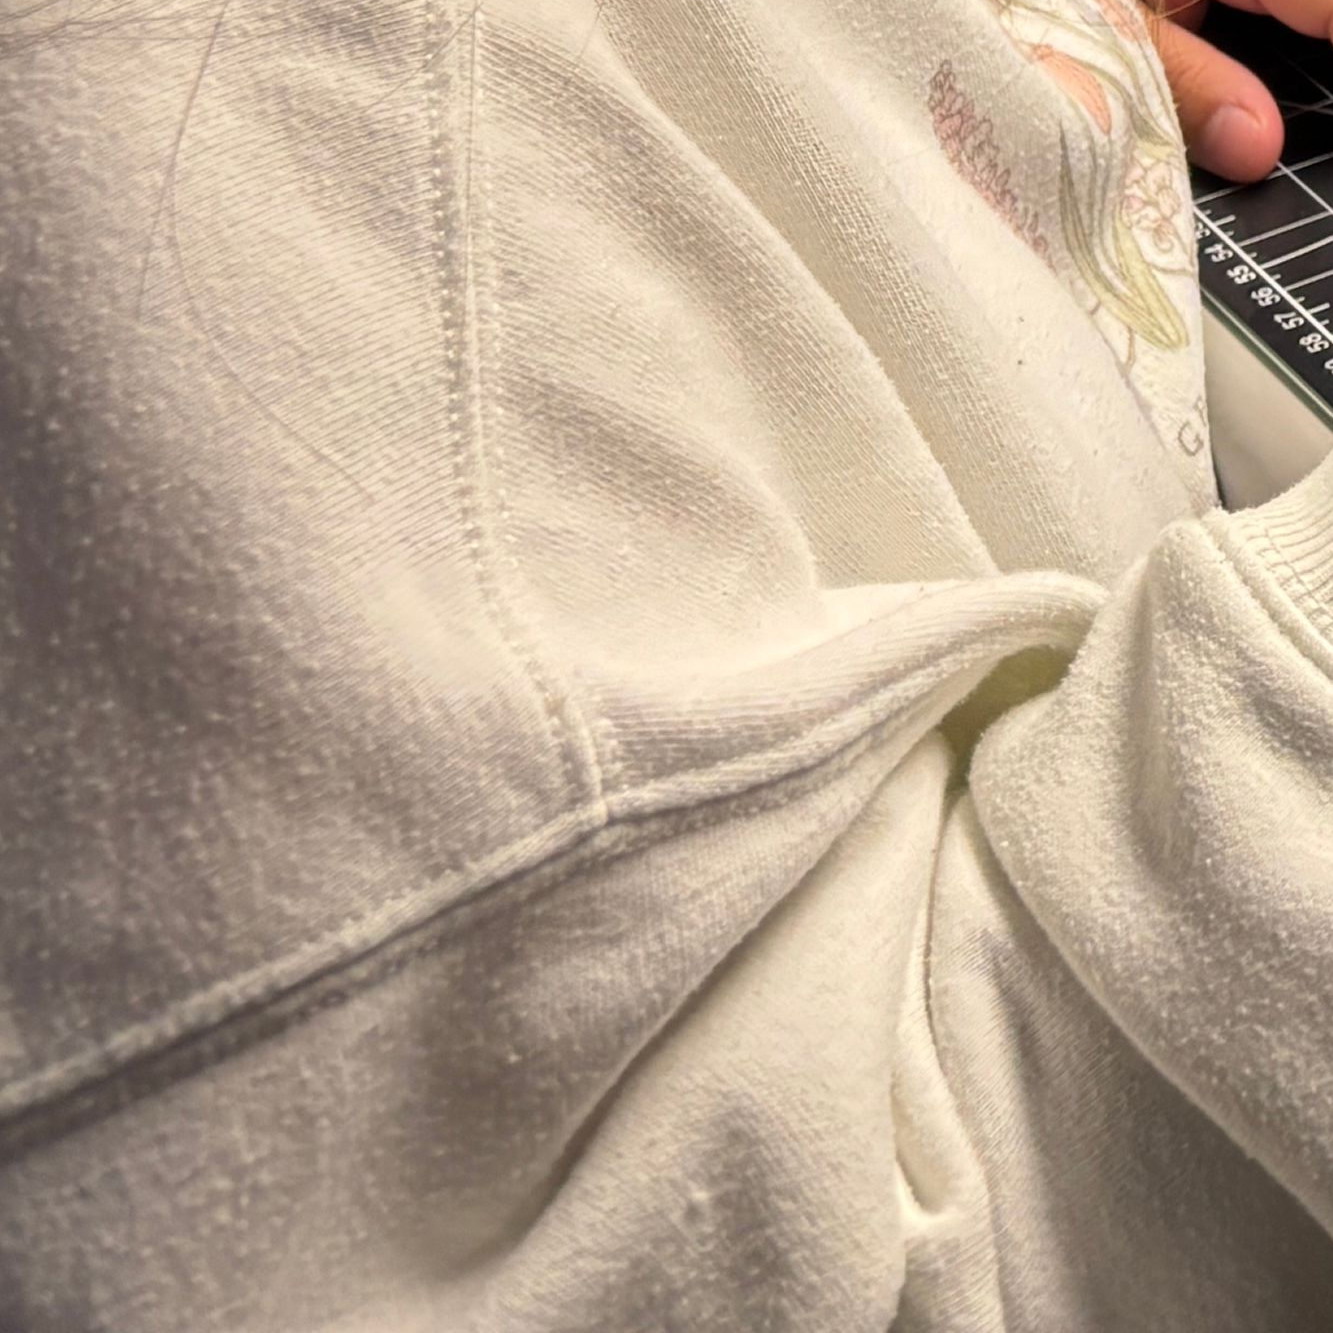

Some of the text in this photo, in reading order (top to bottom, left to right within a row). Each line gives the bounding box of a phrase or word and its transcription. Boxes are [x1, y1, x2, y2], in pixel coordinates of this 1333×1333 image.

[1204, 243, 1234, 263] 54
[1226, 264, 1257, 285] 55
[1250, 286, 1281, 307] 56
[1273, 311, 1305, 331] 57
[1298, 332, 1330, 354] 58
